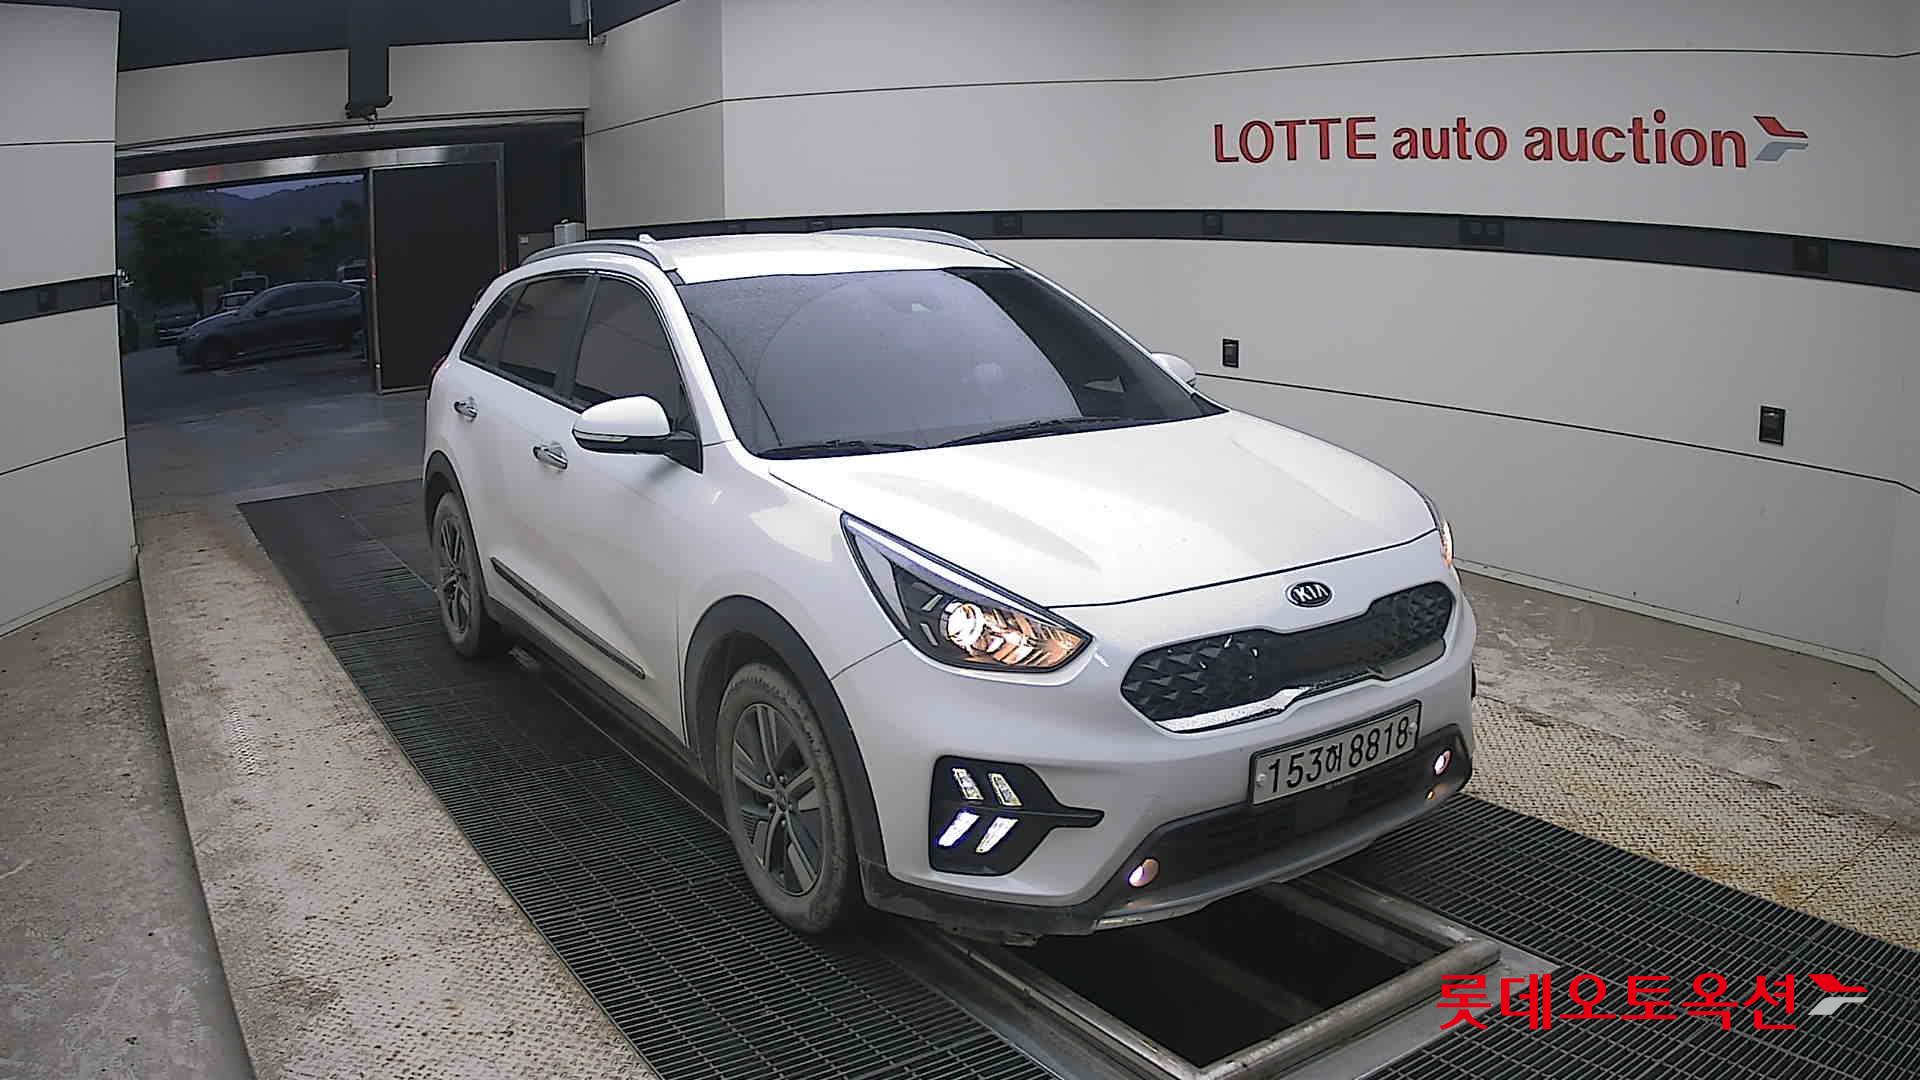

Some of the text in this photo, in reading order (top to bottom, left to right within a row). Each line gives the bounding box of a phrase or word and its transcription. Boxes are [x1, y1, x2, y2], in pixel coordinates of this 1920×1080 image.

[1214, 109, 1747, 168] LOTTE auto auction
[1293, 584, 1329, 602] KIA
[1348, 716, 1409, 768] 8818
